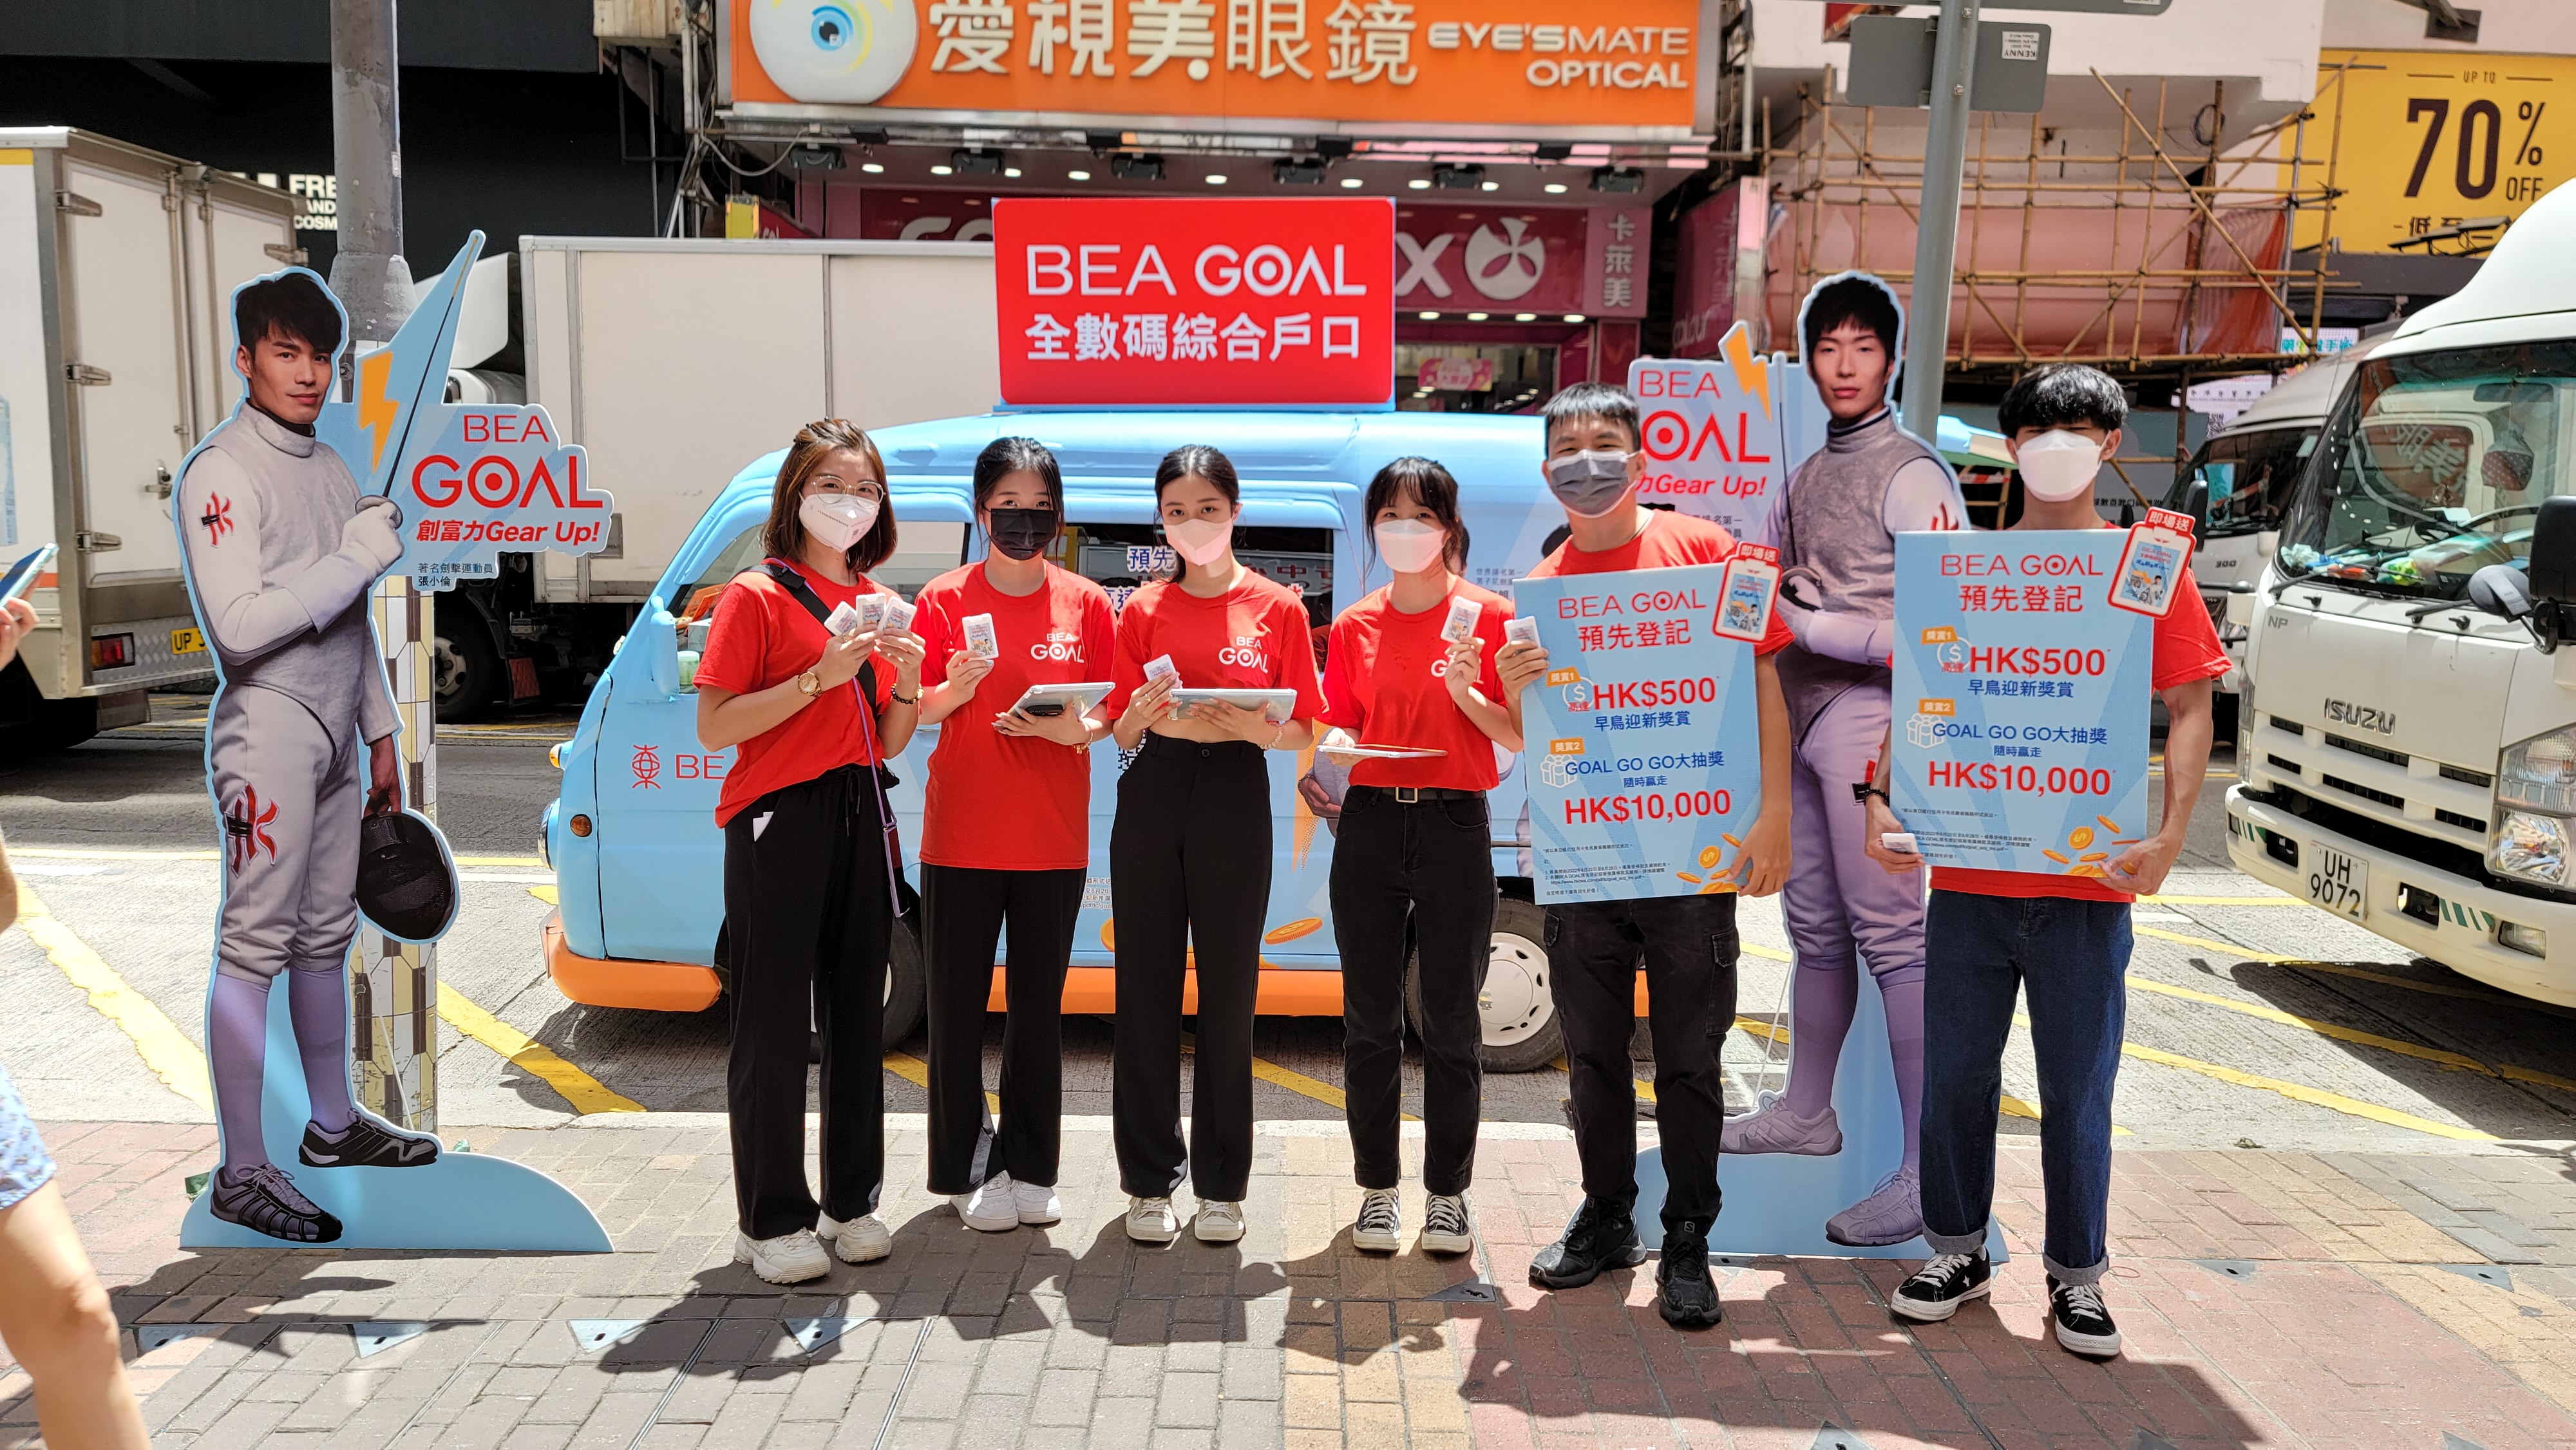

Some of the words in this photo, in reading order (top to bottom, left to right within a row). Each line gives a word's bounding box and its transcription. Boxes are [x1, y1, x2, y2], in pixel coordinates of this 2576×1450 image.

[929, 0, 1417, 86] 愛視美眼鏡
[1526, 61, 1689, 89] OPTICAL
[2463, 70, 2478, 83] UP
[2481, 71, 2496, 84] TO
[289, 174, 337, 199] FRE
[2506, 177, 2543, 202] OFF
[293, 216, 338, 231] COSM
[1027, 244, 1177, 296] BEA
[1195, 243, 1367, 297] GOAL
[1604, 212, 1636, 308] 卡萊美
[1025, 312, 1360, 362] 全數碼綜合戶口
[1639, 370, 1721, 399] BEA
[463, 415, 549, 443] BEA
[1641, 410, 1770, 463] OAL
[412, 455, 603, 509] GOAL
[1722, 476, 1766, 500] Up!
[555, 522, 601, 546] Up!
[2148, 511, 2190, 532] 即場送
[1941, 554, 2011, 577] BEA
[2020, 554, 2103, 576] GOAL
[418, 576, 451, 587] 張小倫
[1558, 596, 1624, 619] BEA
[1631, 588, 1707, 614] GOAL
[1959, 584, 2084, 614] 預先登記
[1046, 632, 1075, 643] BEA
[1236, 636, 1262, 650] BEA
[1578, 619, 1691, 652] 預先登記
[1030, 643, 1084, 664] GOAL
[1218, 646, 1269, 674] GOAL
[1967, 679, 2074, 698] 早鳥迎新獎賞
[1594, 710, 1691, 732] 早鳥迎新獎賞
[2324, 697, 2396, 737] ISUZU
[1933, 722, 1984, 739] GOAL
[1988, 725, 2017, 740] GO
[676, 755, 726, 780] BE
[1565, 758, 1613, 776] GOAL
[1616, 757, 1643, 771] GO
[2324, 850, 2351, 885] UH
[2310, 873, 2361, 918] 9072
